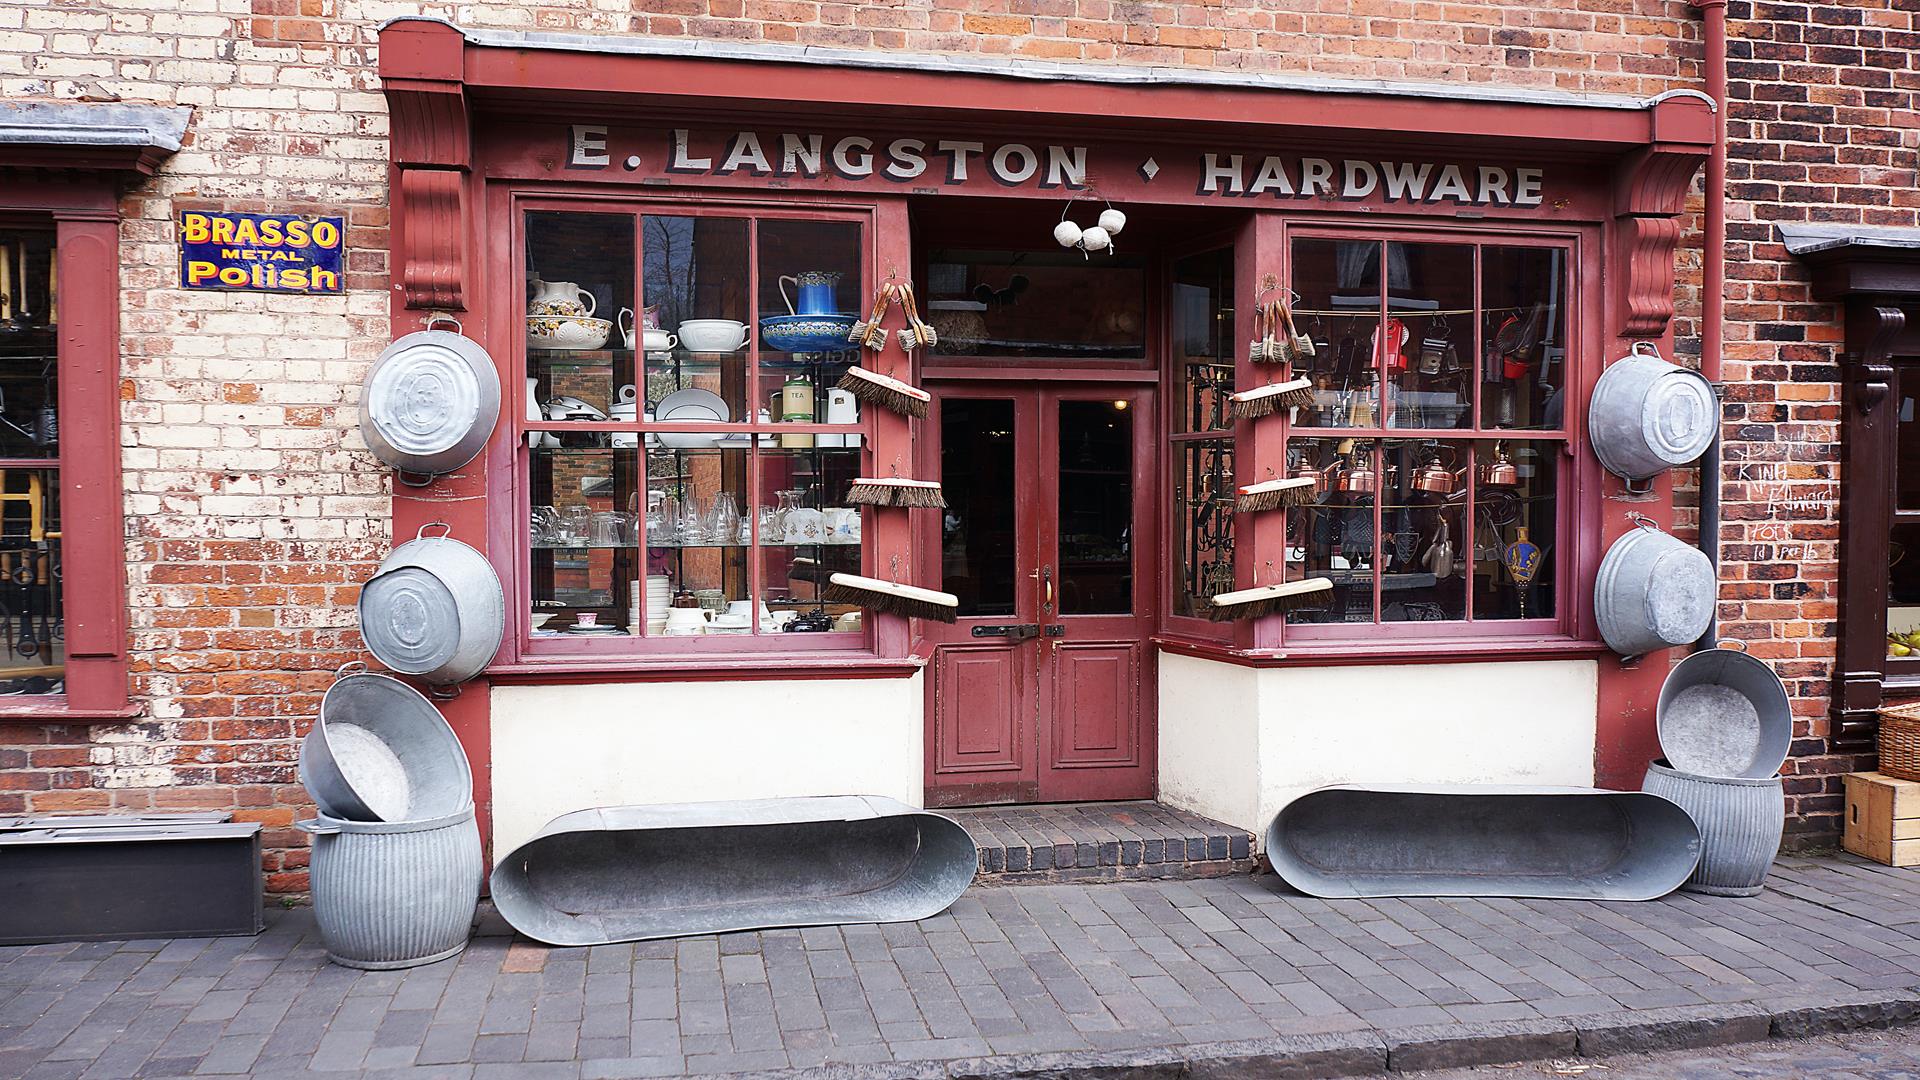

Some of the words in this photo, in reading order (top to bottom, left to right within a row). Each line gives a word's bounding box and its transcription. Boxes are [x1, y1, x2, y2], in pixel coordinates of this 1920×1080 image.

[567, 124, 641, 170] E.
[667, 128, 1087, 189] LANGSTON
[1198, 152, 1543, 208] HARDWARE
[185, 213, 339, 249] BRASSO
[221, 248, 305, 262] METAL
[187, 260, 338, 291] Polish
[1779, 545, 1801, 561] per
